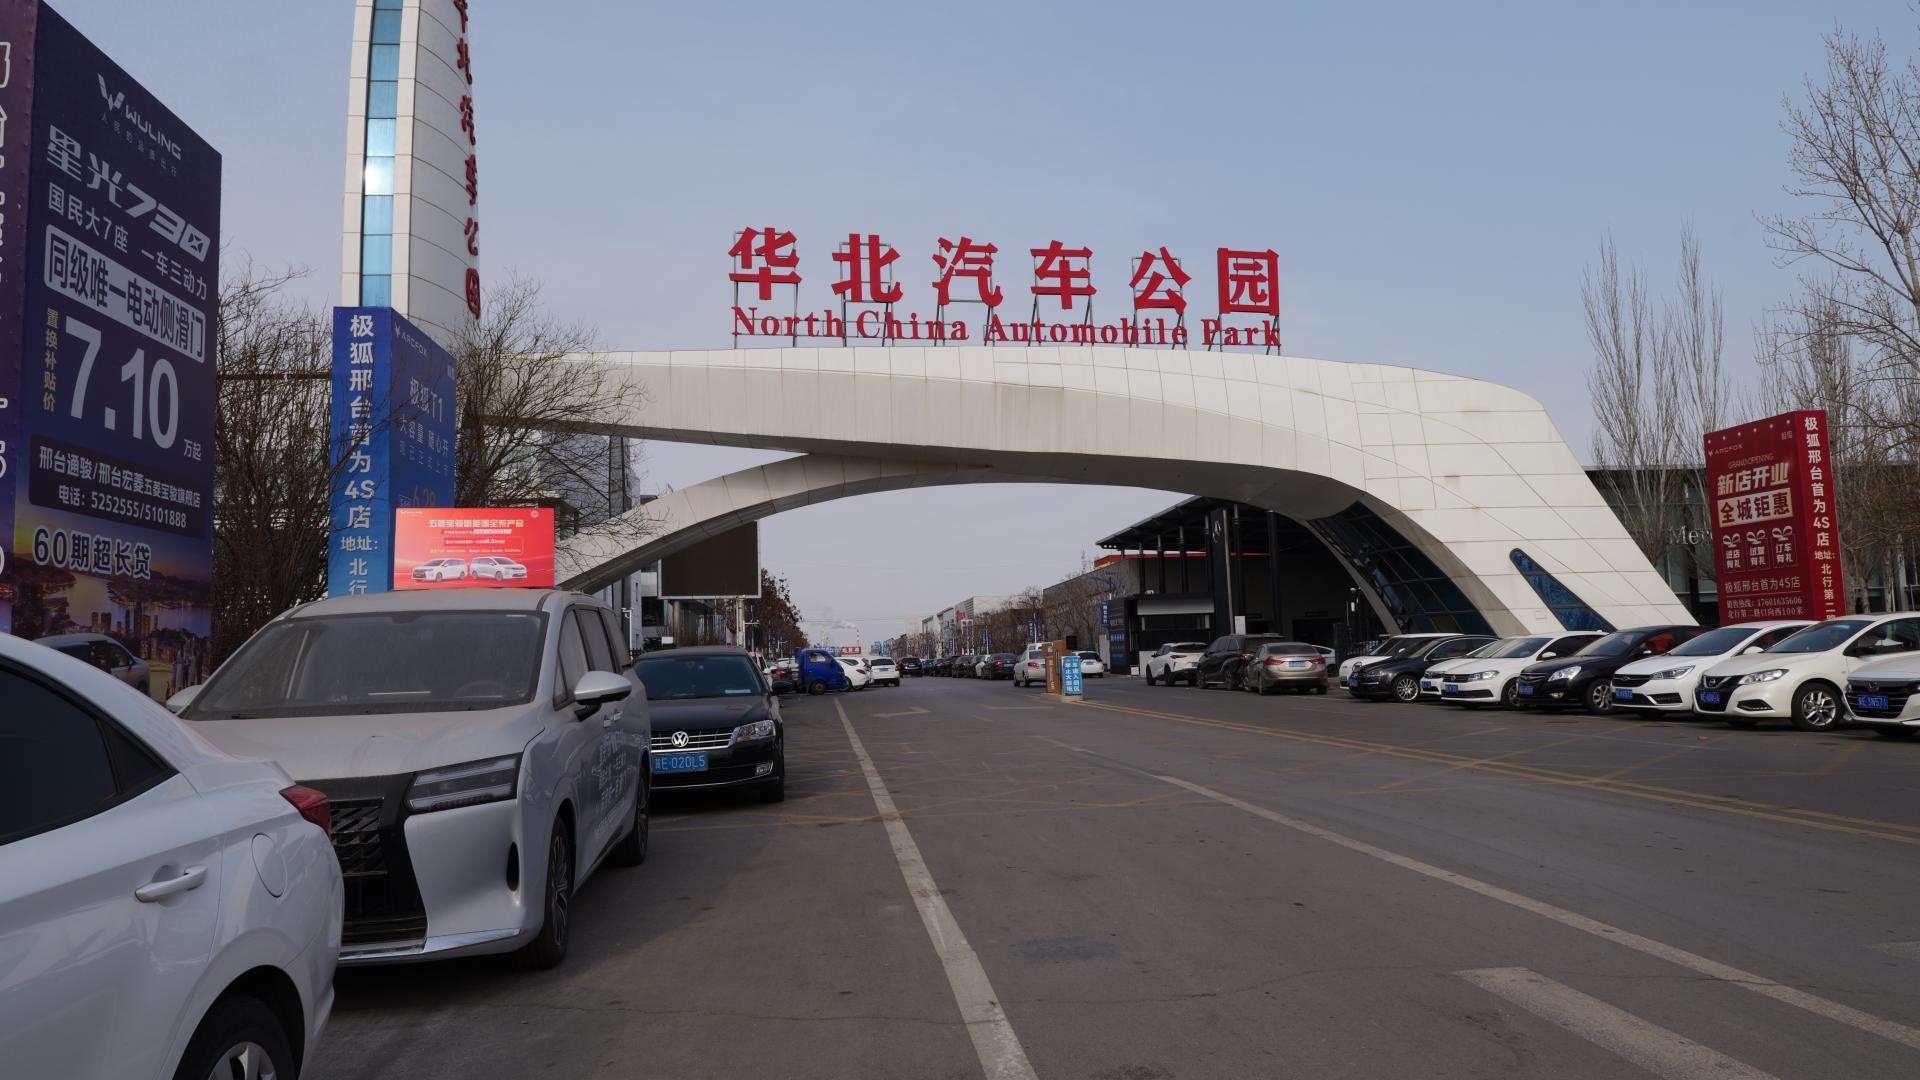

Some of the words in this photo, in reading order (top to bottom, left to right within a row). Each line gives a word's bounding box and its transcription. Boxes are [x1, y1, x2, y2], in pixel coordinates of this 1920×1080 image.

[125, 104, 182, 161] WULING
[48, 182, 129, 254] 国民大7座
[141, 248, 207, 300] 一车三动力
[50, 238, 204, 360] 同级唯一电动侧滑门
[729, 226, 1280, 317] 华北汽车公园
[731, 306, 844, 338] North
[856, 309, 970, 342] China
[984, 313, 1188, 346] Automobile
[1201, 318, 1282, 347] Park
[43, 308, 59, 412] 置换补贴价
[65, 315, 180, 449] 7.10
[345, 314, 375, 529] 极狐邢台首为4S店
[39, 445, 201, 508] 邢台通骏/邢台宏菱五菱宝骏旗舰店
[184, 439, 202, 462] 万起
[1728, 458, 1747, 470] GRAND
[1747, 452, 1775, 466] OPENING
[1717, 462, 1790, 496] 新店开业
[1804, 416, 1830, 547] 极狐邢台首为4S店
[1719, 491, 1791, 524] 全城钜惠
[33, 525, 151, 579] 60期超长贷
[340, 535, 379, 551] 地址：
[349, 558, 369, 596] 北行
[1725, 576, 1801, 593] 极狐邢台首为4S店
